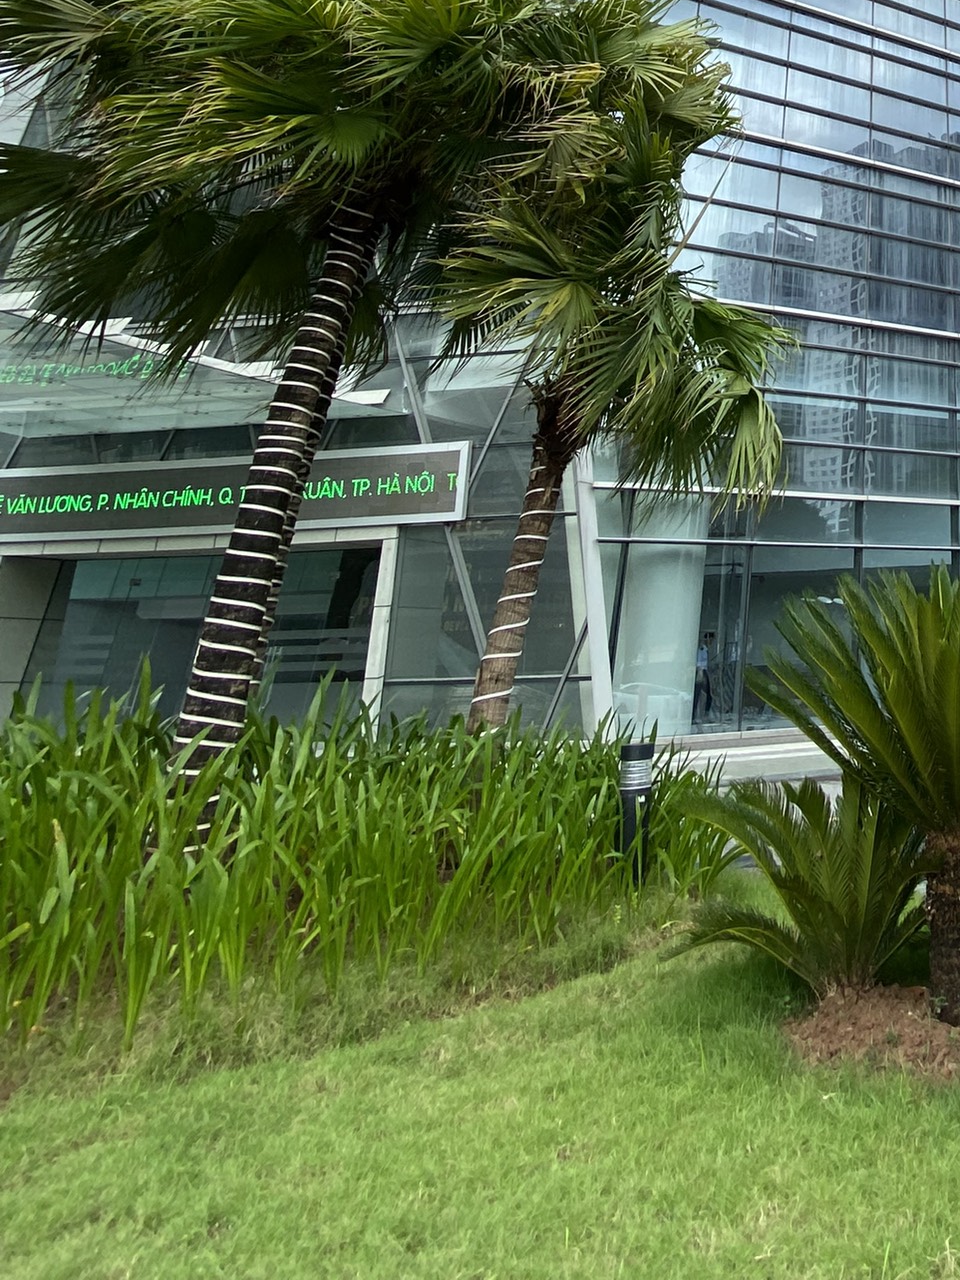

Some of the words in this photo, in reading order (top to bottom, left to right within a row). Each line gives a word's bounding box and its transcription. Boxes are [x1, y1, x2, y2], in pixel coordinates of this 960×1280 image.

[7, 494, 37, 514] VĂN
[97, 493, 109, 511] P.
[114, 486, 160, 510] NHÂN
[162, 485, 214, 507] CHÍNH,
[218, 487, 234, 505] Q.
[352, 478, 372, 497] TP.
[377, 472, 401, 495] HÀ
[405, 470, 435, 496] NỘI
